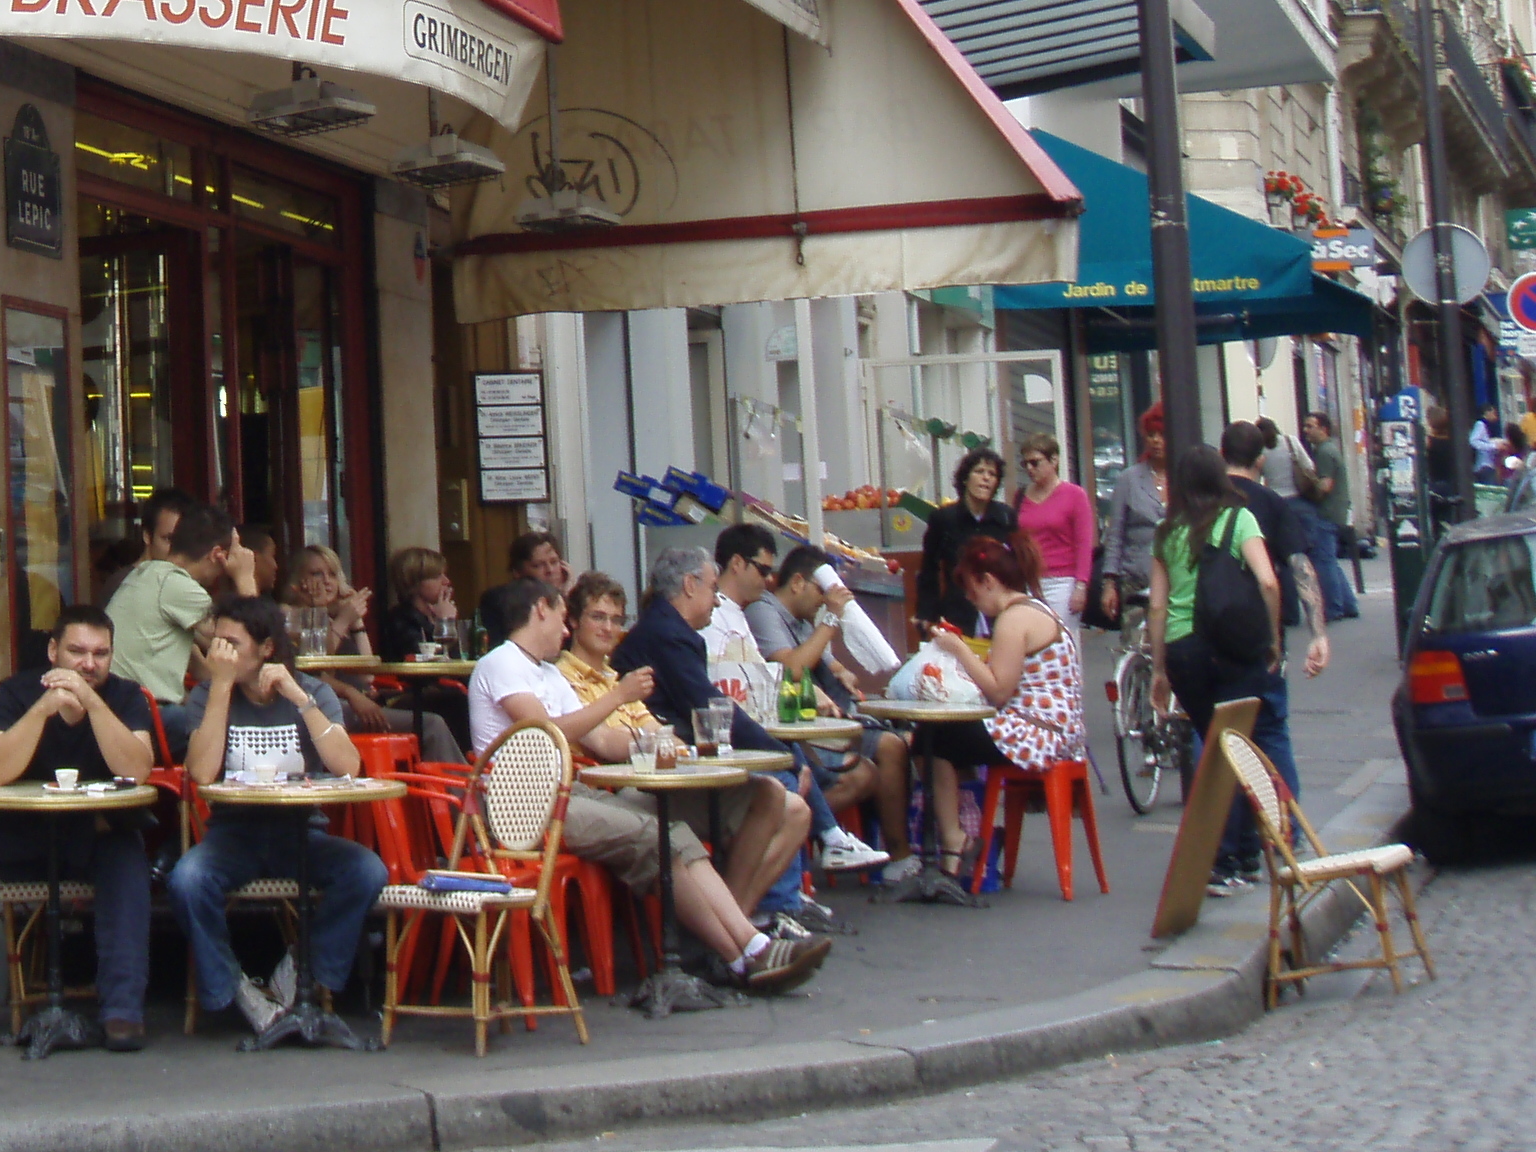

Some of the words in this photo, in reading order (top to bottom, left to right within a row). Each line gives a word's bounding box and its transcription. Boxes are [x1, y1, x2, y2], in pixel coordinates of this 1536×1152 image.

[413, 13, 513, 86] GRIMBERGEN
[21, 168, 46, 198] RUE
[18, 200, 52, 231] LEPIC
[1063, 282, 1116, 298] Jardin
[1124, 281, 1148, 296] de
